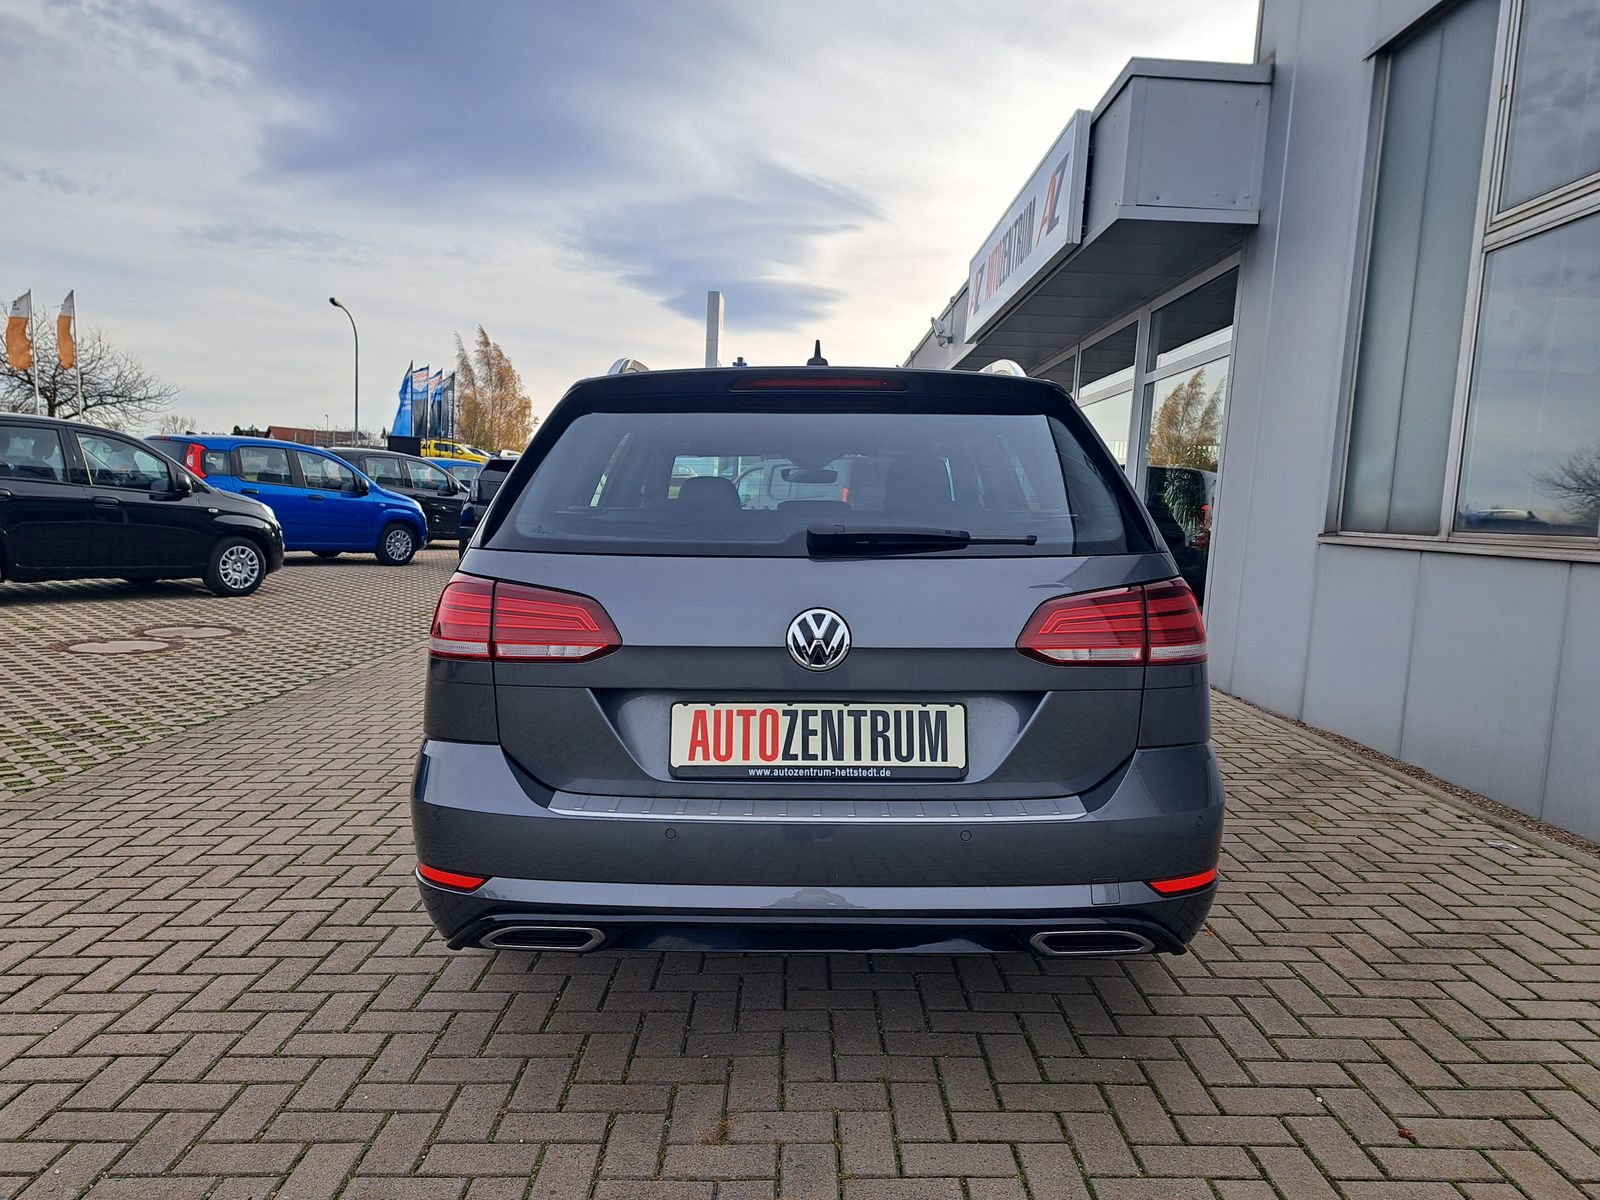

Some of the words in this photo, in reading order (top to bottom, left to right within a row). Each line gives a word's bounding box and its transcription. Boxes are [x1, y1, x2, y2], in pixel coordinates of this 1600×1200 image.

[984, 195, 1036, 302] AUTOZENTRUM
[1036, 151, 1070, 248] AZ
[687, 707, 949, 763] AUTOZENTRUM
[748, 767, 891, 777] www.autozentrum-hettstedt.de
